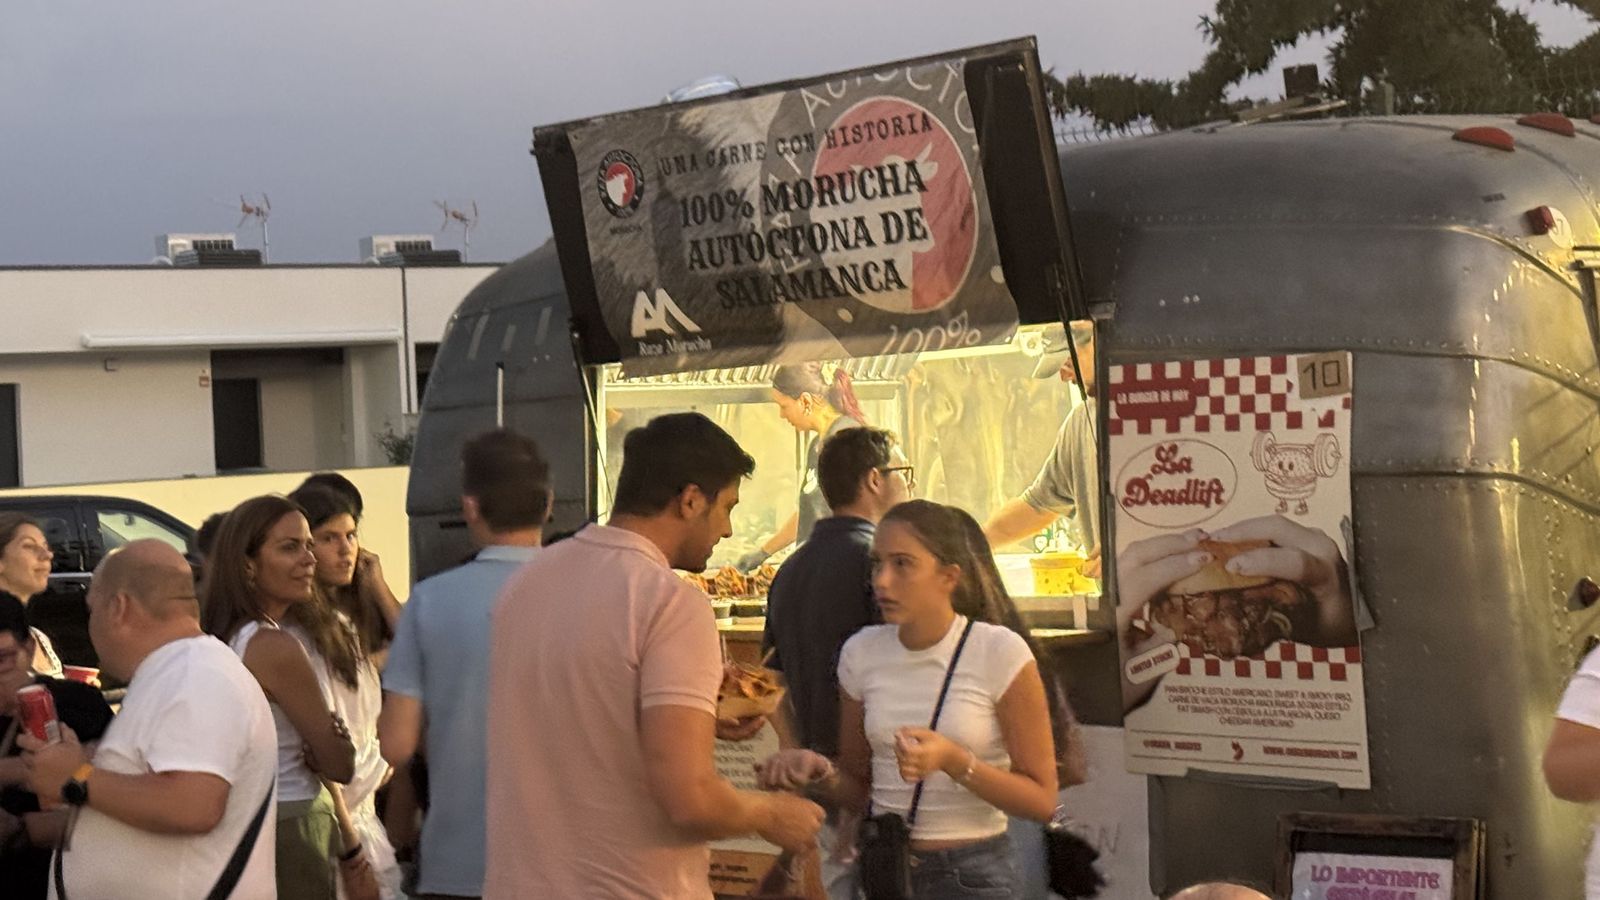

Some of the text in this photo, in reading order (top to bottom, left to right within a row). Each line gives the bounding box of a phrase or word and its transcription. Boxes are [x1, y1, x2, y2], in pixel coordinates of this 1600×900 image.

[659, 111, 933, 177] UNA CARNE CON HISTORIA
[680, 159, 929, 228] 100% MORUCHA
[688, 207, 929, 272] AUTÓCTONA DE
[716, 258, 909, 311] SALAMANCA
[1302, 359, 1341, 391] 10
[1151, 443, 1194, 476] La
[1122, 472, 1226, 509] Deadlift
[1310, 864, 1333, 882] LO
